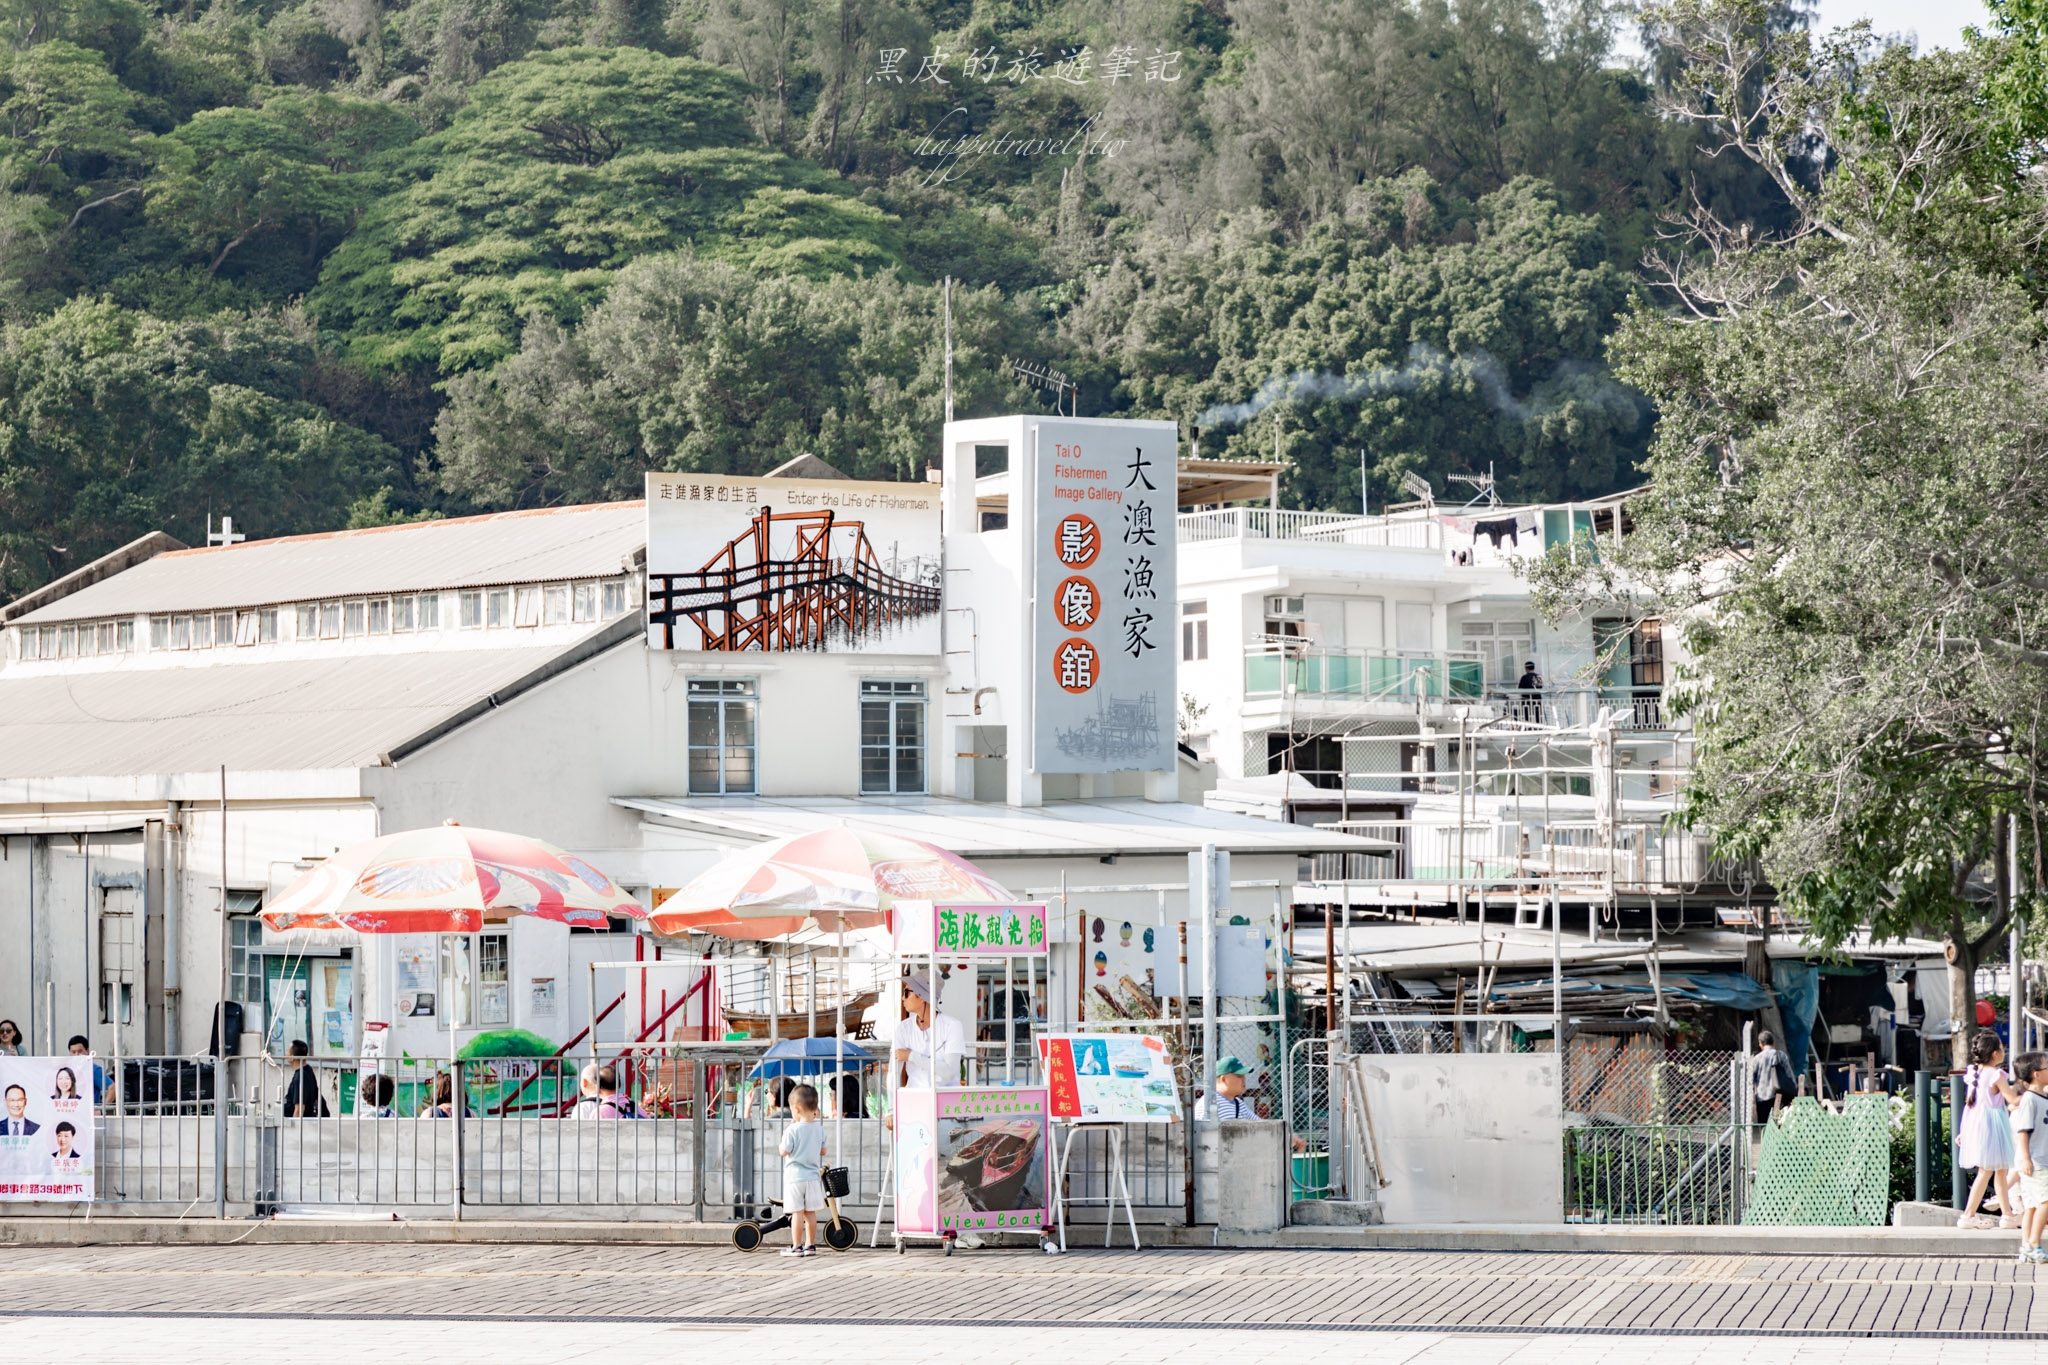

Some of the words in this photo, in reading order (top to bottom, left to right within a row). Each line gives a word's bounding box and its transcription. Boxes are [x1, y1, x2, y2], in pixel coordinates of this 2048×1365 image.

[1055, 444, 1071, 458] Tai
[1073, 446, 1082, 458] O
[1055, 465, 1108, 480] Fishermen
[660, 483, 757, 503] 走進漁家的生活
[787, 490, 818, 505] Enter
[821, 492, 839, 506] the
[842, 493, 862, 508] Life
[865, 494, 878, 508] of
[880, 495, 929, 510] Fishermen
[1055, 485, 1085, 503] Image
[1087, 487, 1123, 504] Gallery
[1123, 447, 1158, 658] 大澳漁家
[938, 908, 1043, 952] 海豚觀光船
[943, 1214, 987, 1228] View
[997, 1211, 1042, 1227] Boat
